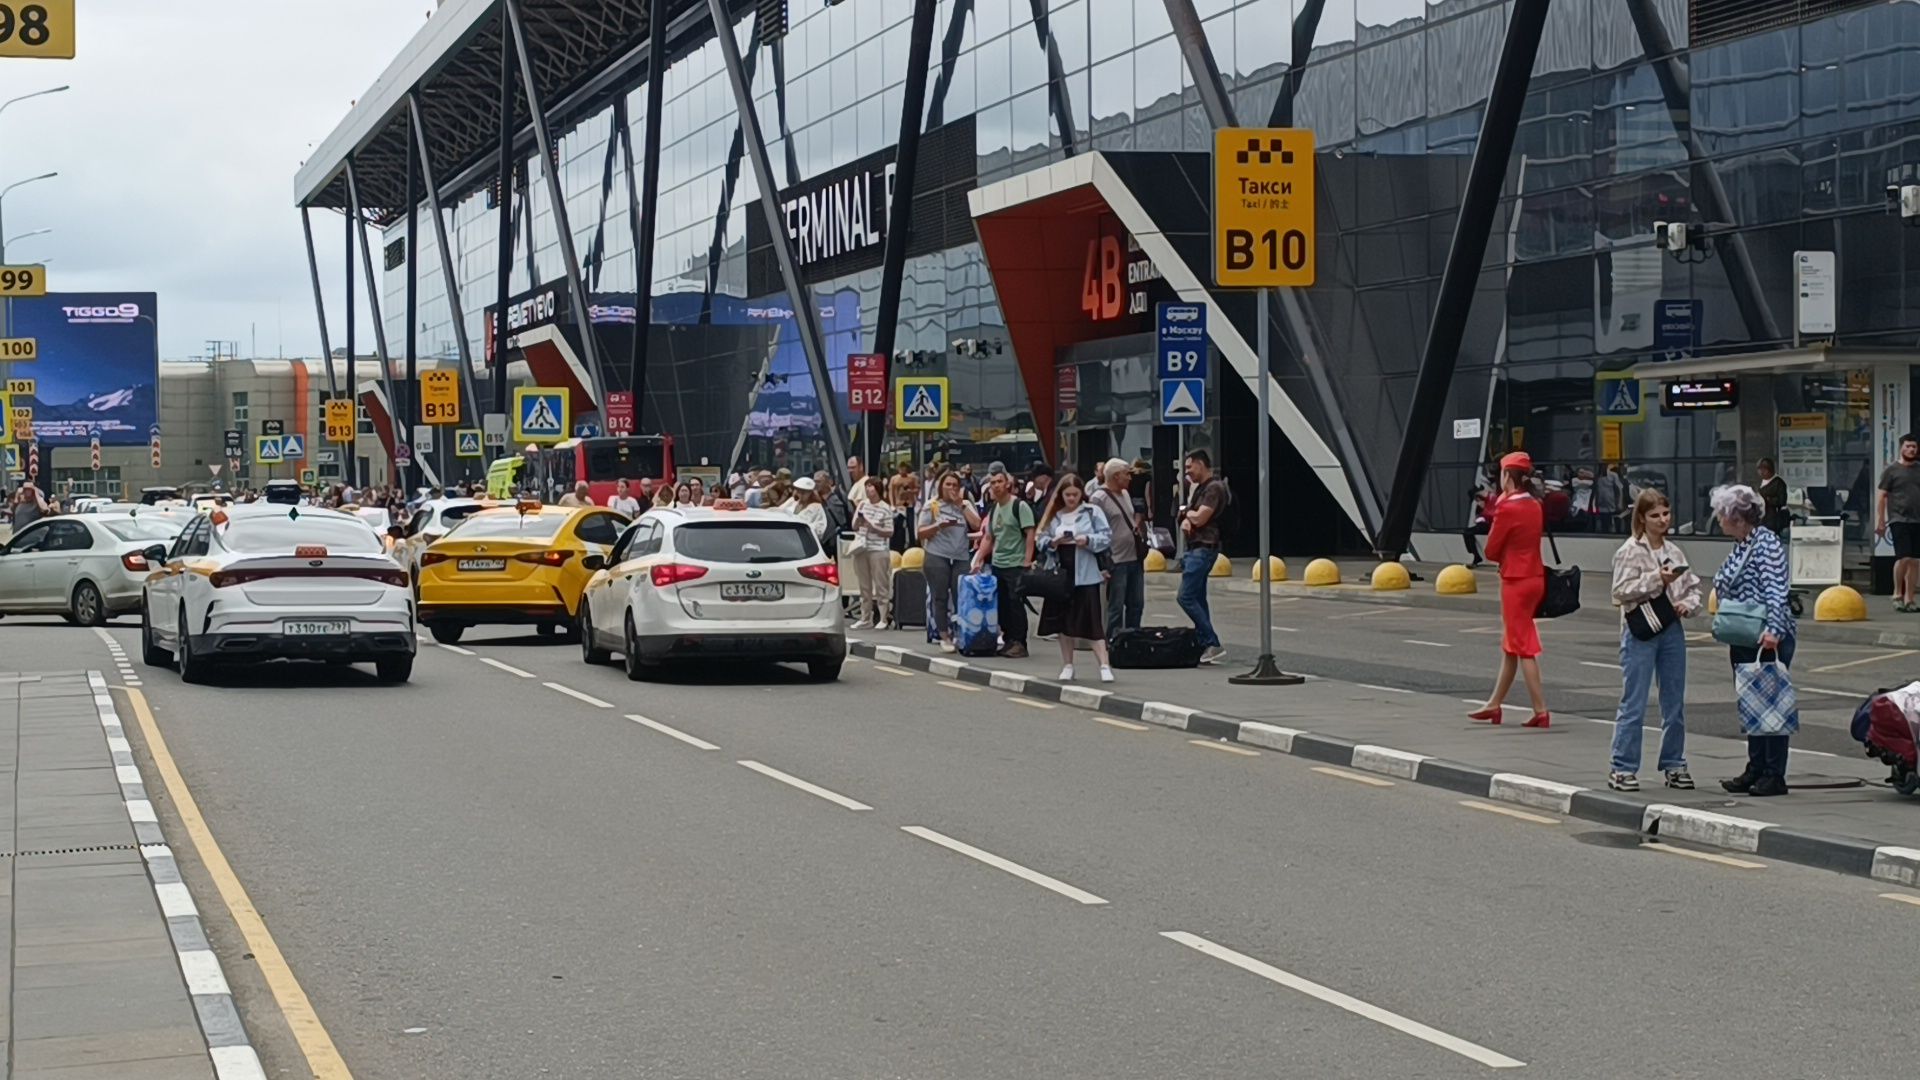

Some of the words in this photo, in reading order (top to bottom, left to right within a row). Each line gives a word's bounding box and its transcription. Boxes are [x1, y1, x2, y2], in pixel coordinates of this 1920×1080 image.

[0, 3, 50, 46] 98
[1238, 177, 1292, 195] Такси
[1242, 199, 1261, 209] Taxi
[782, 171, 880, 265] ERMINAL
[1, 270, 33, 291] 99
[1082, 235, 1122, 320] 4B
[2, 341, 34, 355] 100
[10, 381, 32, 392] 101
